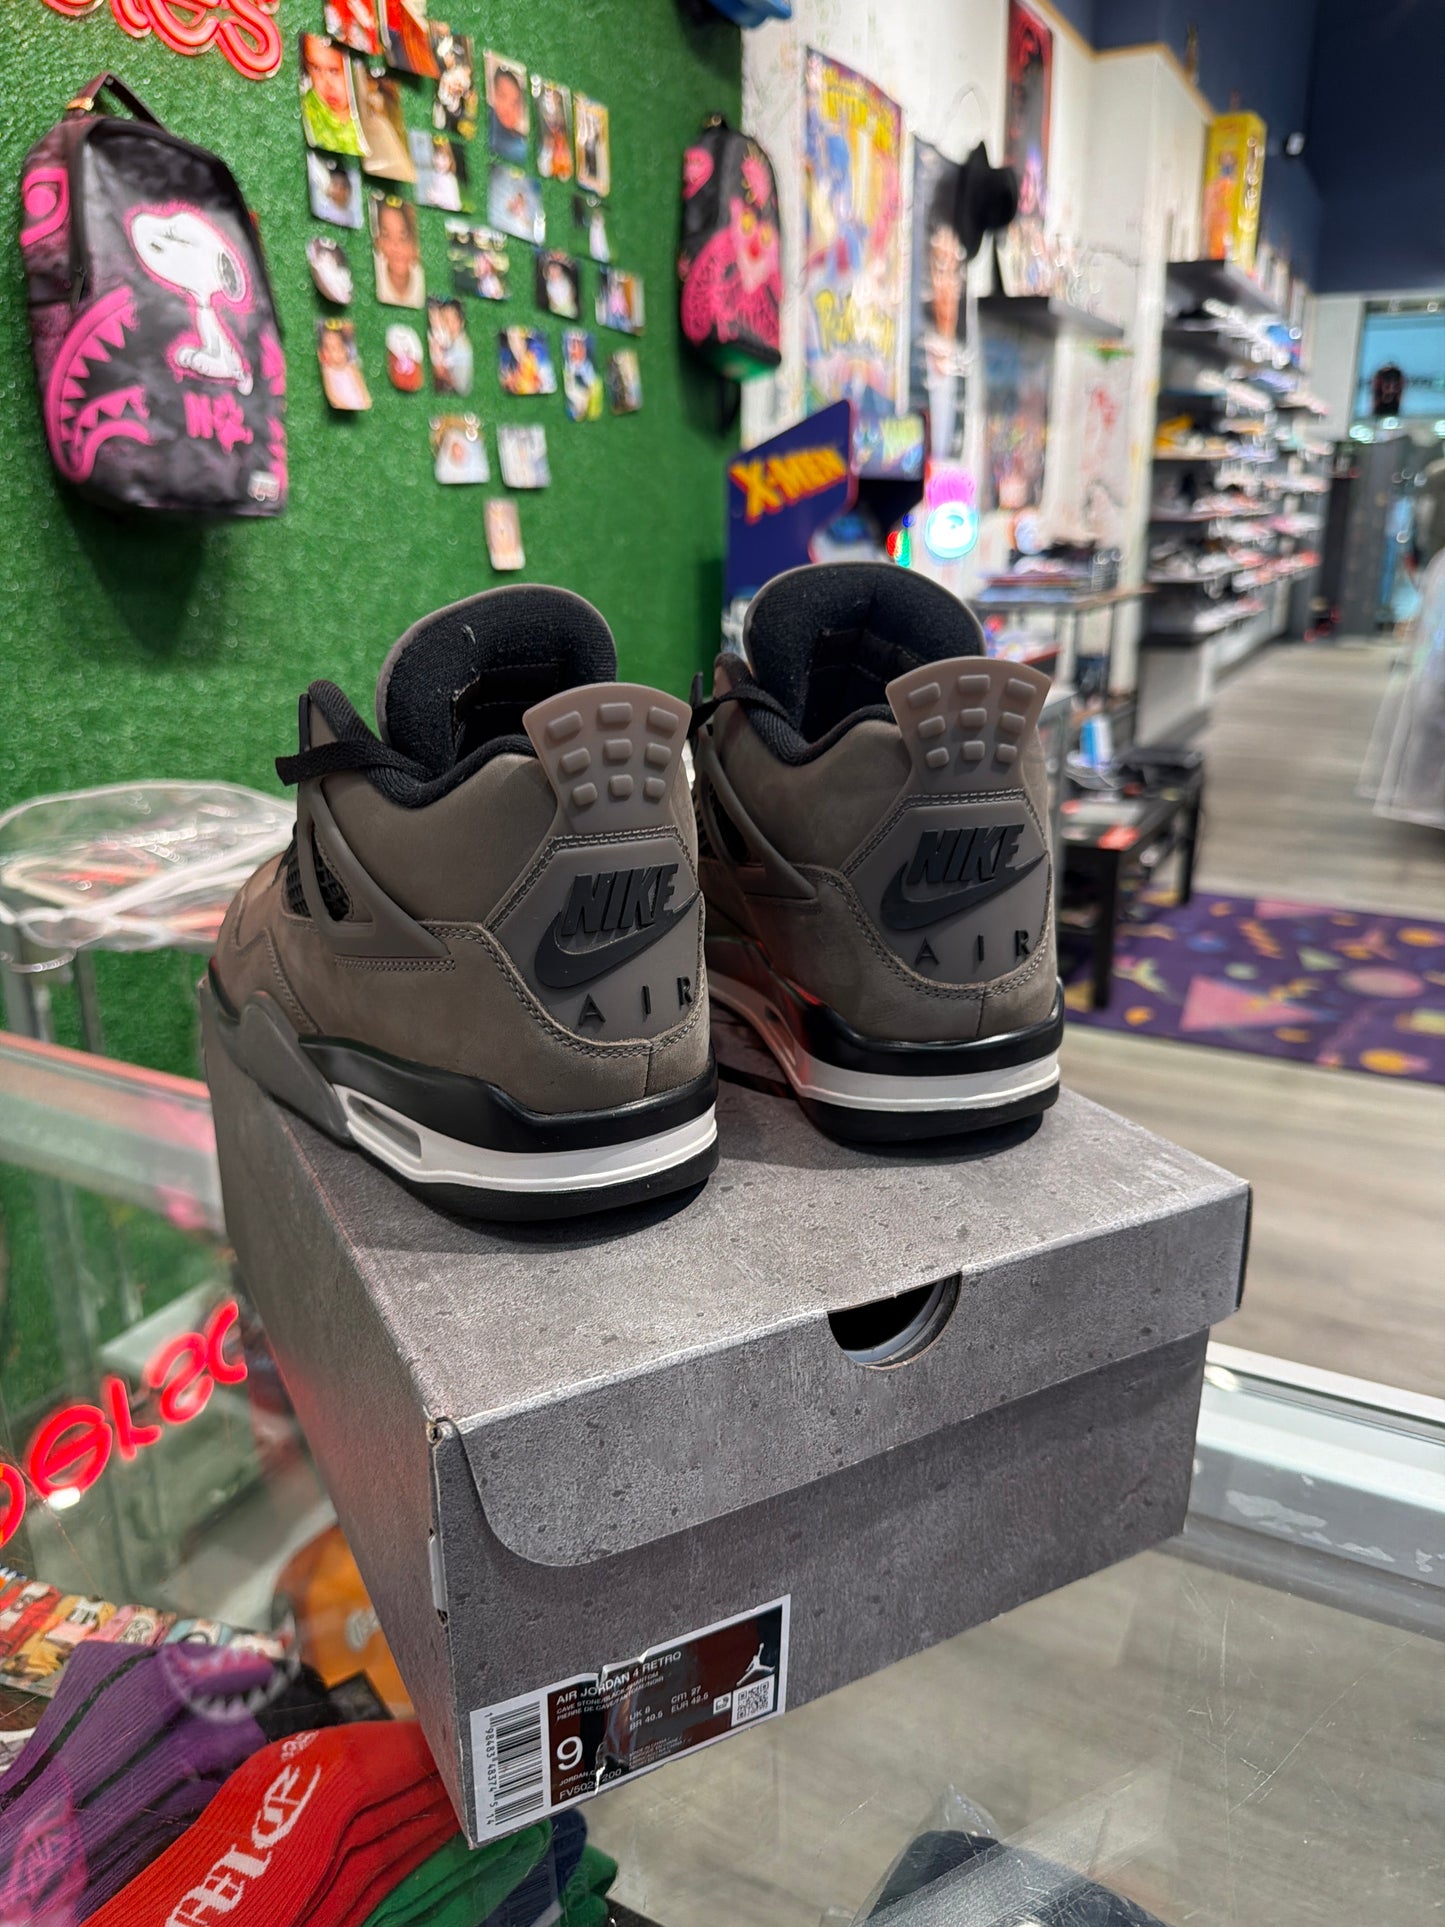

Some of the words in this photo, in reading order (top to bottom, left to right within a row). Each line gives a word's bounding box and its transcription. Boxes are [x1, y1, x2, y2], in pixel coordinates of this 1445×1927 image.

[729, 445, 847, 525] X-MEN
[909, 824, 1024, 884] NIKE
[560, 863, 678, 936] NIKE
[556, 1690, 577, 1706] AIR
[581, 1675, 629, 1697] JORDAN
[633, 1668, 638, 1677] 4
[642, 1651, 681, 1670] RETRO
[691, 1685, 701, 1696] 27
[630, 1720, 642, 1730] BR
[671, 1700, 688, 1713] EUR
[485, 1728, 496, 1758] 98483
[557, 1736, 582, 1770] 9
[487, 1764, 497, 1792] 48374
